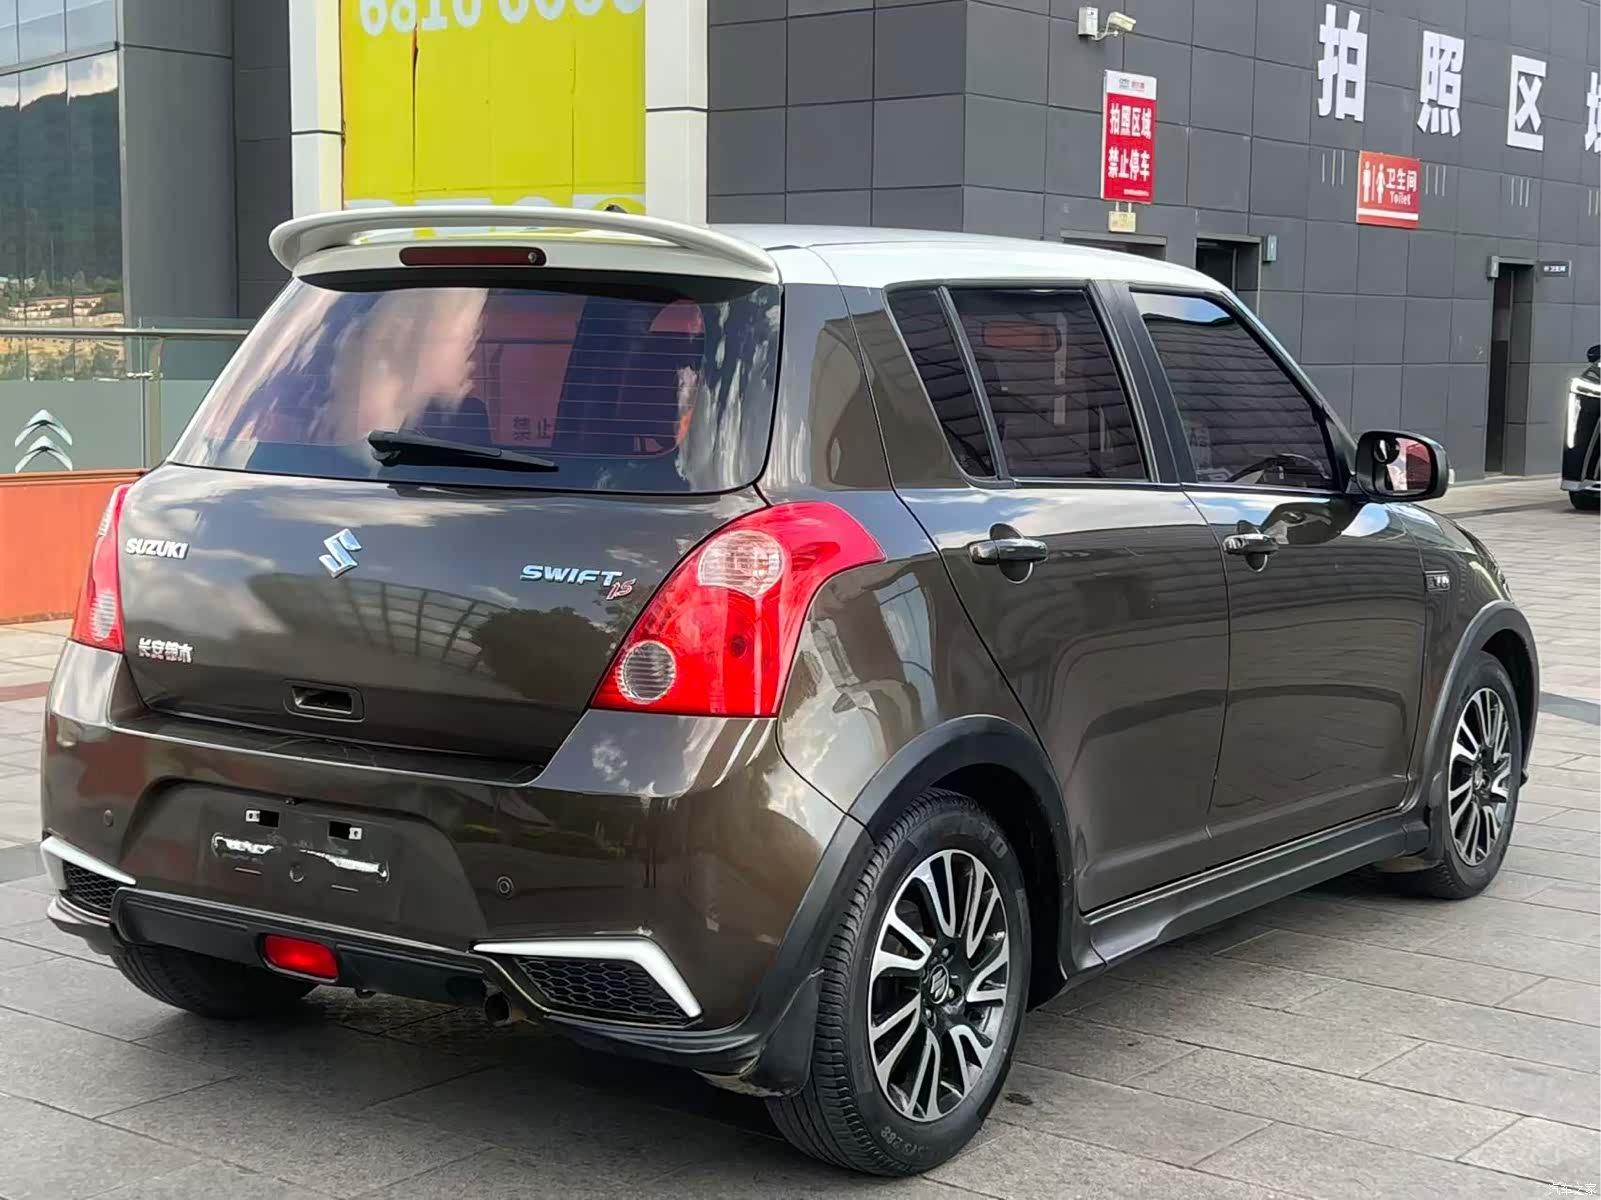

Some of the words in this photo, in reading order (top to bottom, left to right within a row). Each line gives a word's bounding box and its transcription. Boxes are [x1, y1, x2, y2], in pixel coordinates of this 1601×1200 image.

[1110, 103, 1151, 139] 拍照区域
[1107, 147, 1150, 181] 禁止停车
[1386, 167, 1417, 192] 卫生间
[1389, 190, 1411, 205] Toilet
[126, 537, 189, 559] SUZUKI
[520, 564, 623, 587] SWIFT
